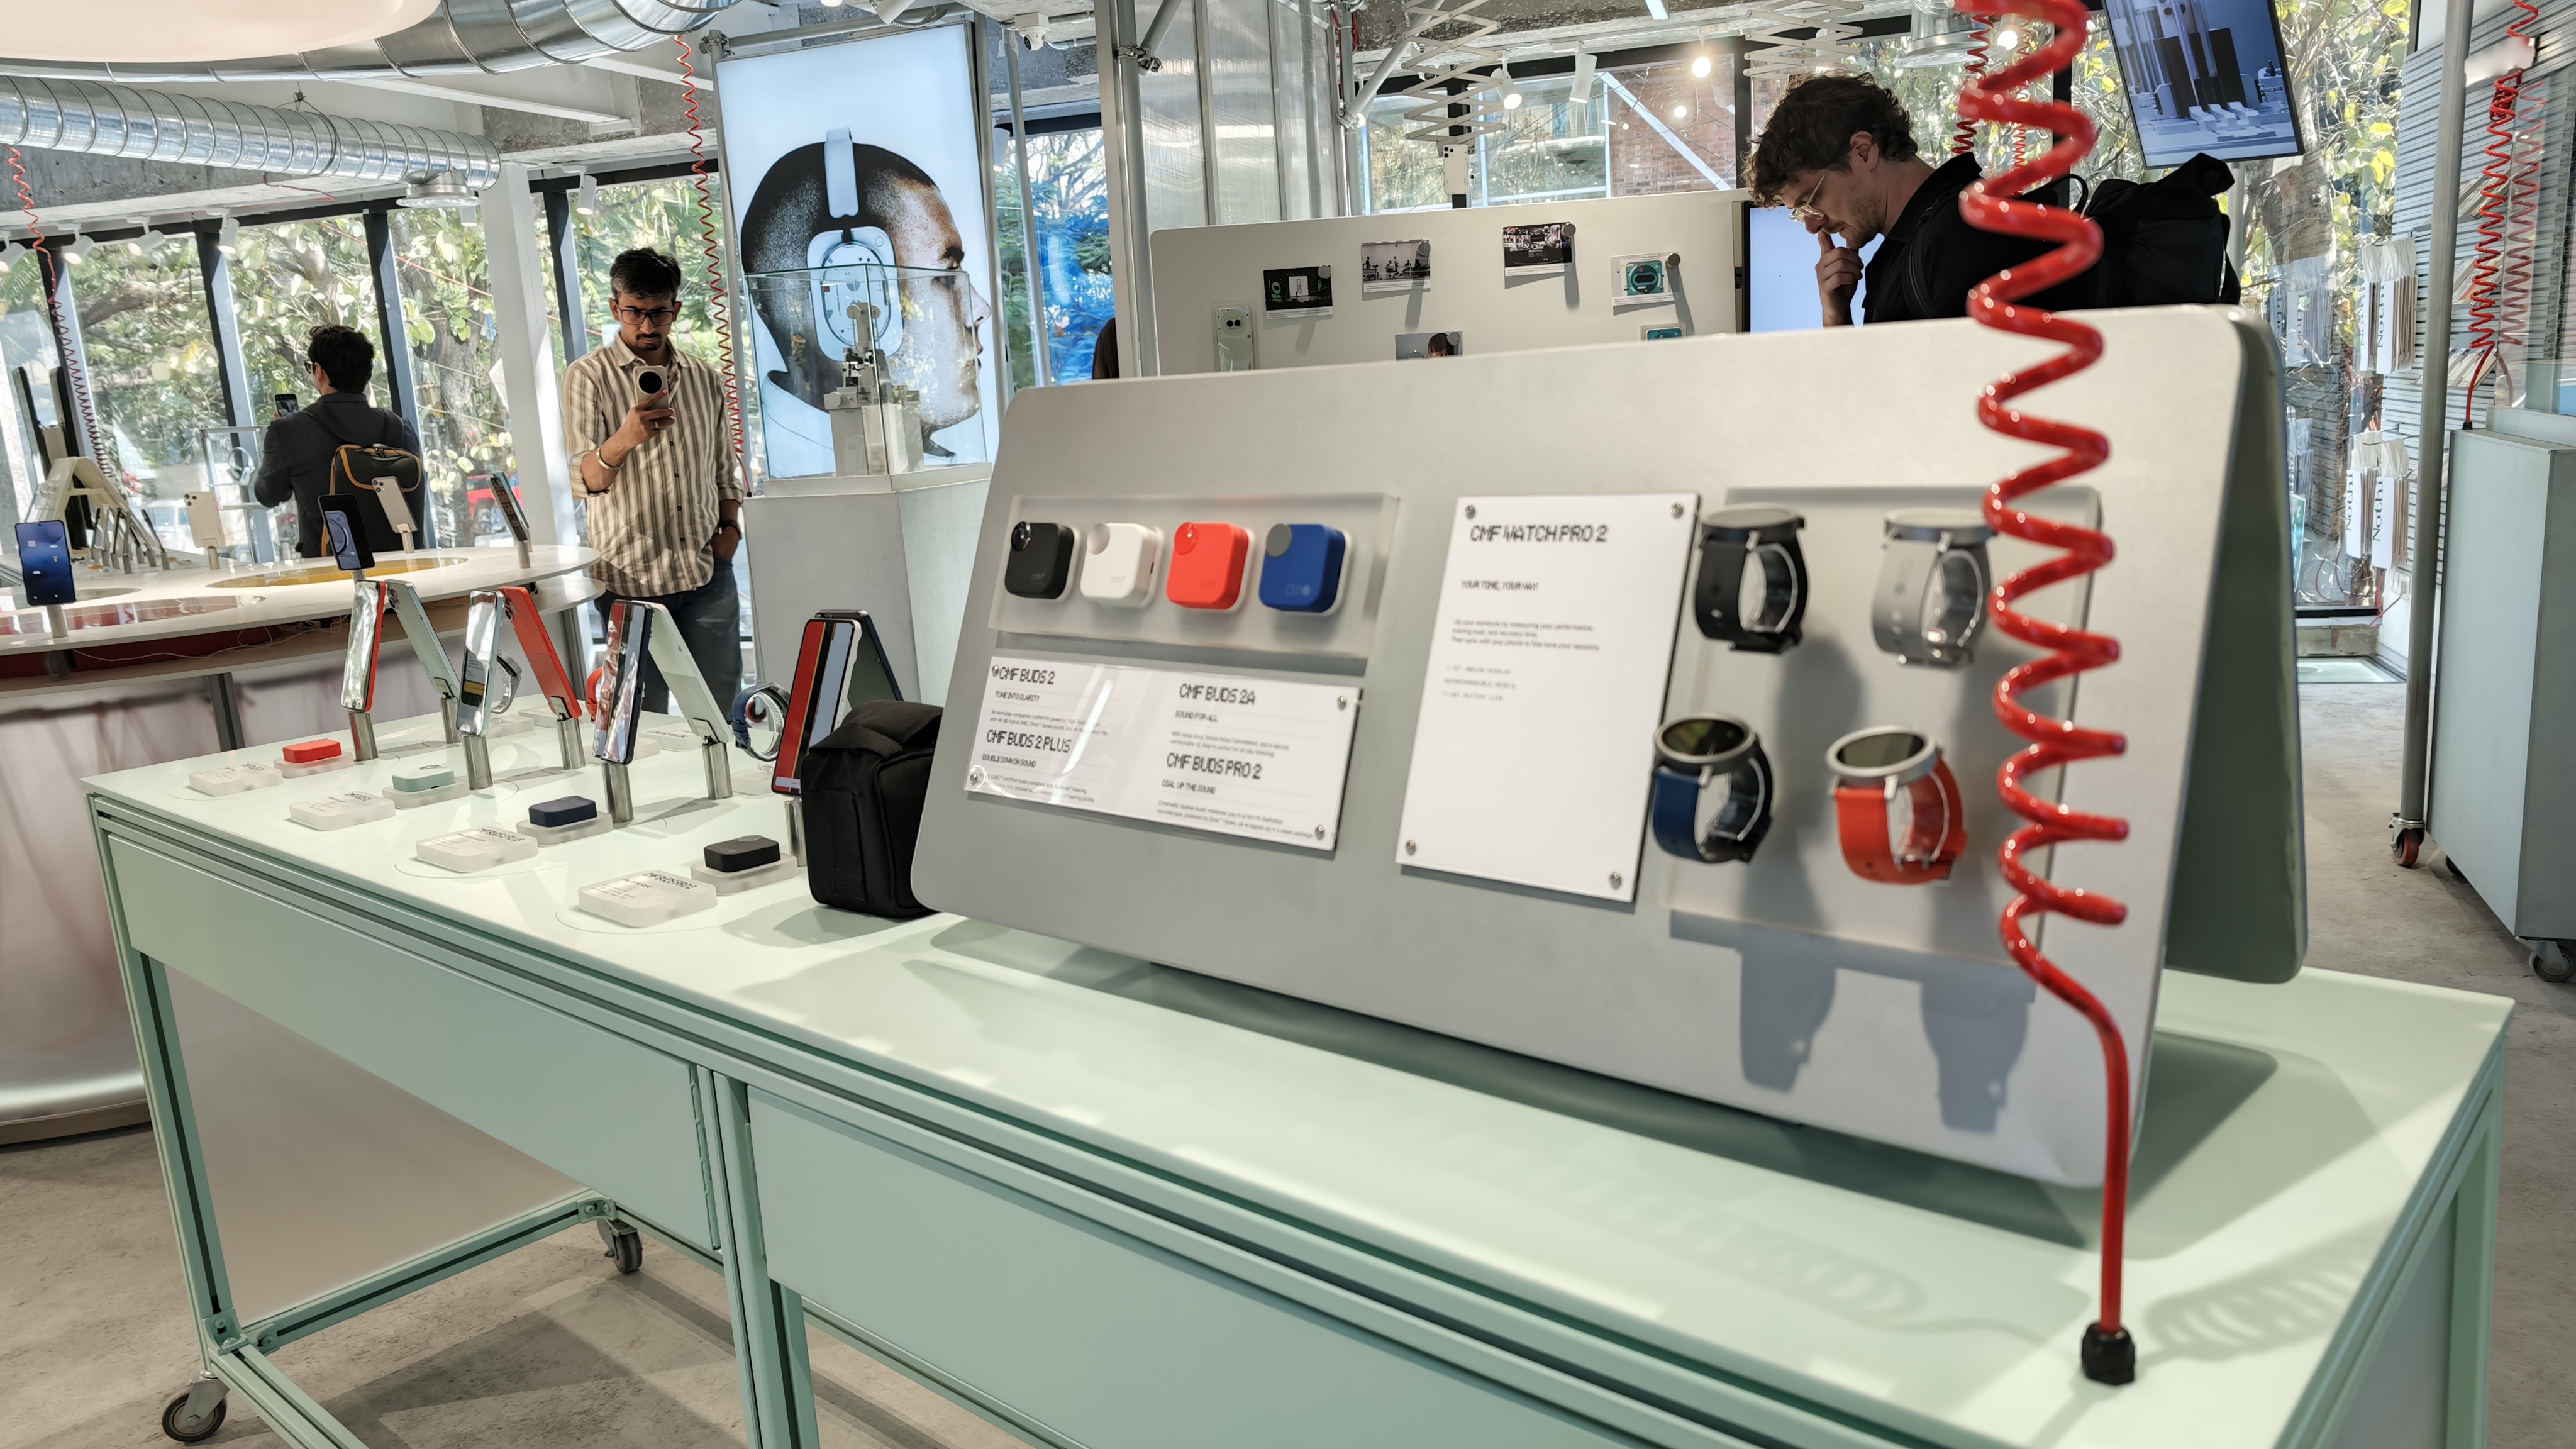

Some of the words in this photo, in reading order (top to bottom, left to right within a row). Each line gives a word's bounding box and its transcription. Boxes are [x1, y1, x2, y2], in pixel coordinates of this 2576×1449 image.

[1470, 525, 1501, 542] CMF
[1503, 525, 1558, 542] WATCH
[1558, 525, 1594, 542] PRO
[1594, 524, 1608, 543] 2
[1461, 580, 1479, 589] YOUR
[1502, 581, 1521, 591] YOUR
[999, 667, 1020, 680] CMF
[1019, 668, 1048, 684] BUDS
[1047, 671, 1055, 685] 2
[1019, 694, 1041, 702] CLARITY
[1179, 683, 1204, 699] CMF
[1205, 686, 1238, 704] BUDS
[1238, 689, 1256, 705] 2A
[1175, 710, 1194, 719] SOUND
[1194, 712, 1206, 721] FOR
[986, 729, 1007, 743] CMF
[1007, 732, 1034, 748] BUDS
[1035, 736, 1043, 749] 2
[1043, 736, 1072, 753] PLUS
[982, 753, 1001, 762] DOUBLE
[1001, 756, 1014, 765] DOWN
[1021, 759, 1036, 768] SOUND
[1167, 752, 1192, 769] CMF
[1192, 756, 1225, 775] BUDS
[1225, 760, 1251, 779] PRO
[1252, 763, 1262, 780] 2
[1162, 779, 1175, 789] DIAL
[1176, 781, 1185, 790] UP
[1185, 782, 1197, 792] THE
[1197, 784, 1216, 794] SOUND
